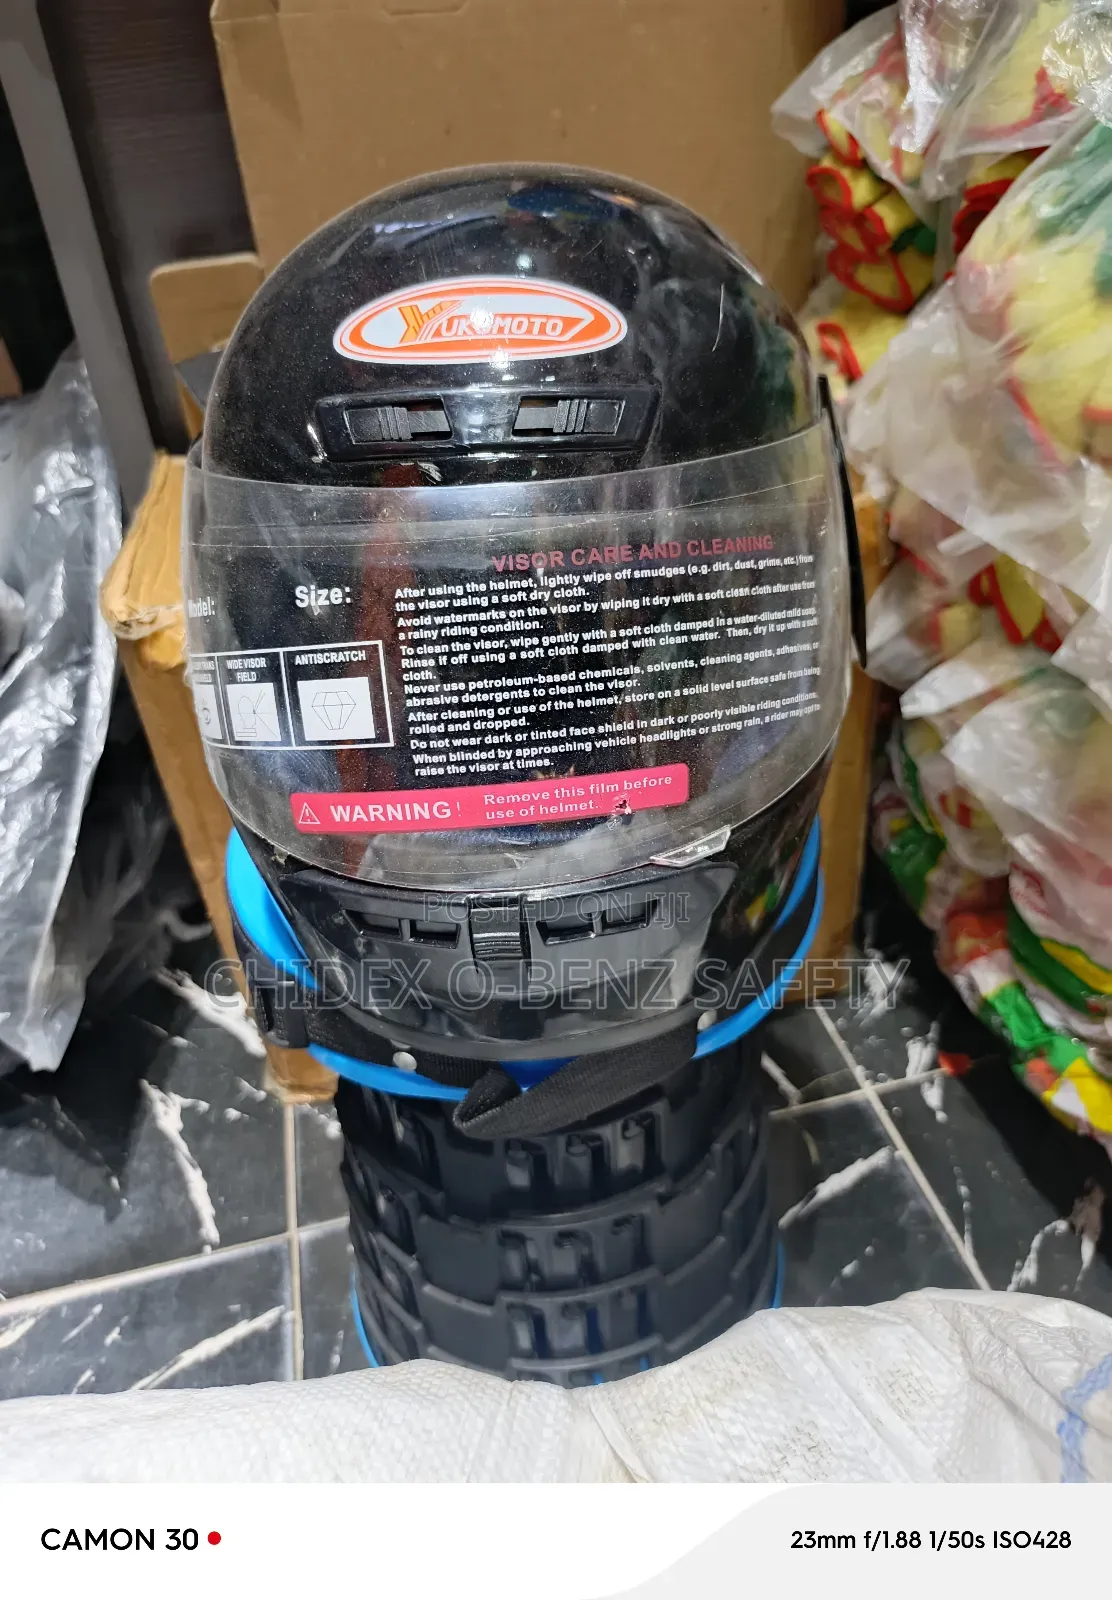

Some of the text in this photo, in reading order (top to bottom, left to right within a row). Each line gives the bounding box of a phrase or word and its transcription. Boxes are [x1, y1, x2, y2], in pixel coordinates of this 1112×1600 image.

[492, 535, 773, 572] VISOR CARE AND CLEANING
[395, 558, 783, 599] After using the helmet, lightly wipe off smudges (e.g. dirt, dust, grime,
[295, 585, 351, 608] Size:
[396, 587, 590, 611] the visor using soft dry cloth.
[397, 583, 789, 627] Avoid watermarks on the visor by wiping dry with soft clean cloth after
[400, 608, 800, 656] To clean the visor, wipe gently with soft cloth damped in water-diluted mild
[408, 621, 544, 641] rainy riding condition.
[295, 650, 366, 665] ANTISCRATCH
[401, 621, 800, 668] Rinse if off using soft cloth damped with clean water. Then, dry with
[226, 658, 267, 669] WIDE VISOR
[403, 670, 437, 681] cloth.
[404, 649, 775, 694] Never use petroleum-based chemicals, solvents, cleaning agents,
[237, 672, 256, 682] FIELD
[406, 678, 641, 706] abrasive detergents to clean the visor.
[408, 672, 786, 722] After cleaning or use of the helmet, store on solid level surface safe
[409, 717, 530, 734] rolled and dropped.
[410, 699, 780, 749] Do not wear dark or tinted face shield in dark poorly visible riding
[413, 709, 803, 764] When blinded by approaching vehicle headlights strong rain, rider may
[415, 757, 554, 777] raise the visor at times.
[483, 775, 672, 806] Remove this film before
[330, 801, 452, 823] WARNING
[485, 800, 600, 820] use of helmet.
